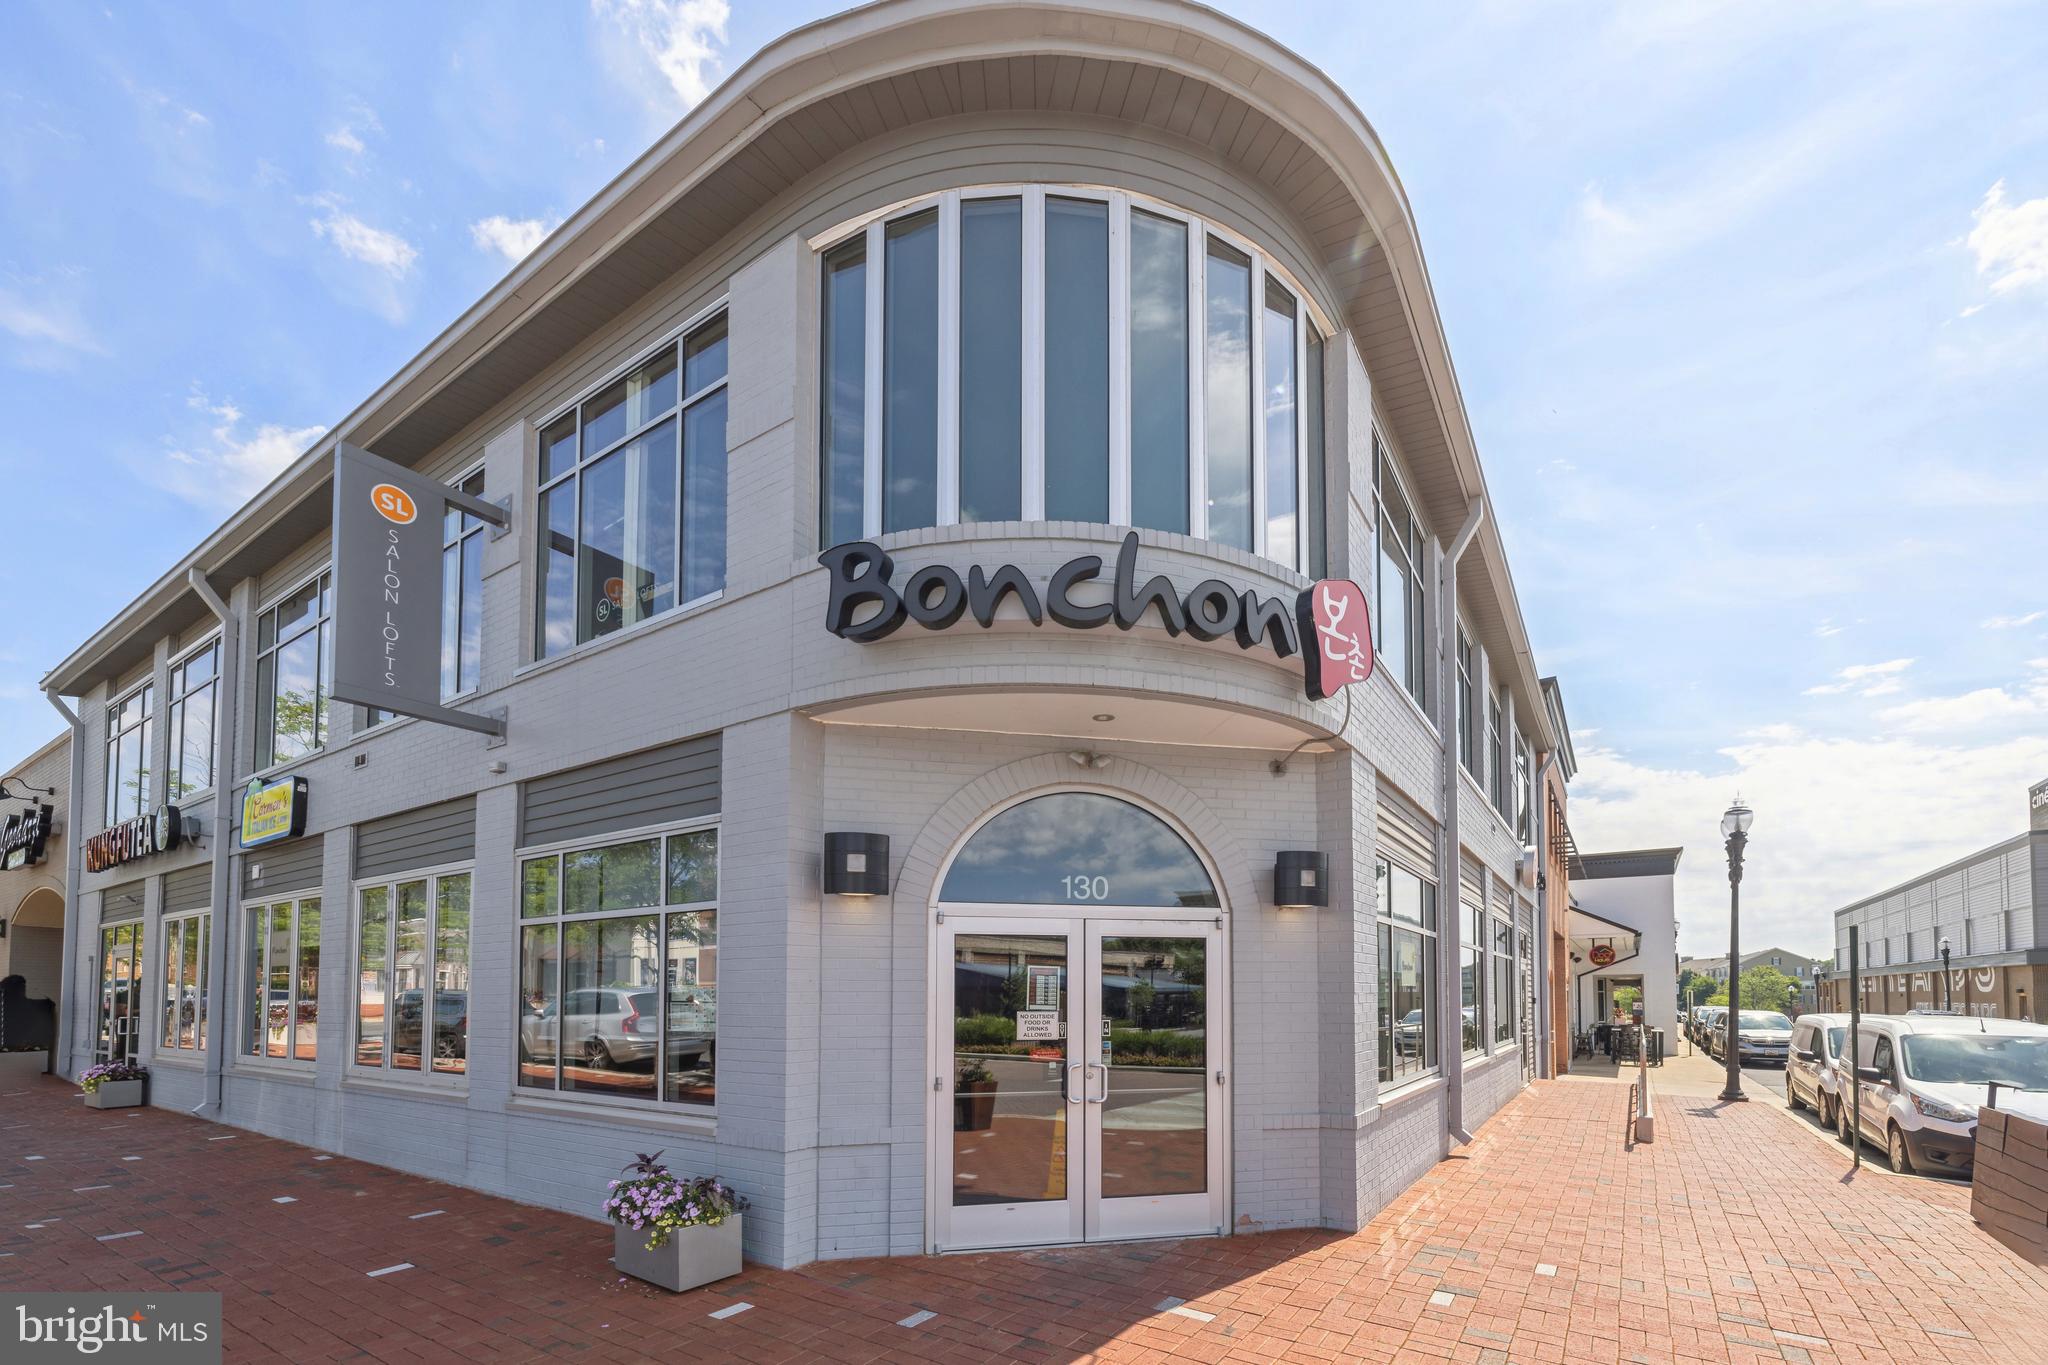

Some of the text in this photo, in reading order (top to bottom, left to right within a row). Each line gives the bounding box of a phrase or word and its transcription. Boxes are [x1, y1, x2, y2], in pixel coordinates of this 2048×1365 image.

[382, 493, 409, 517] SL
[383, 529, 401, 687] SALON LOFTS
[818, 531, 1298, 660] Bonchon
[599, 604, 608, 616] SL
[1061, 875, 1109, 900] 130
